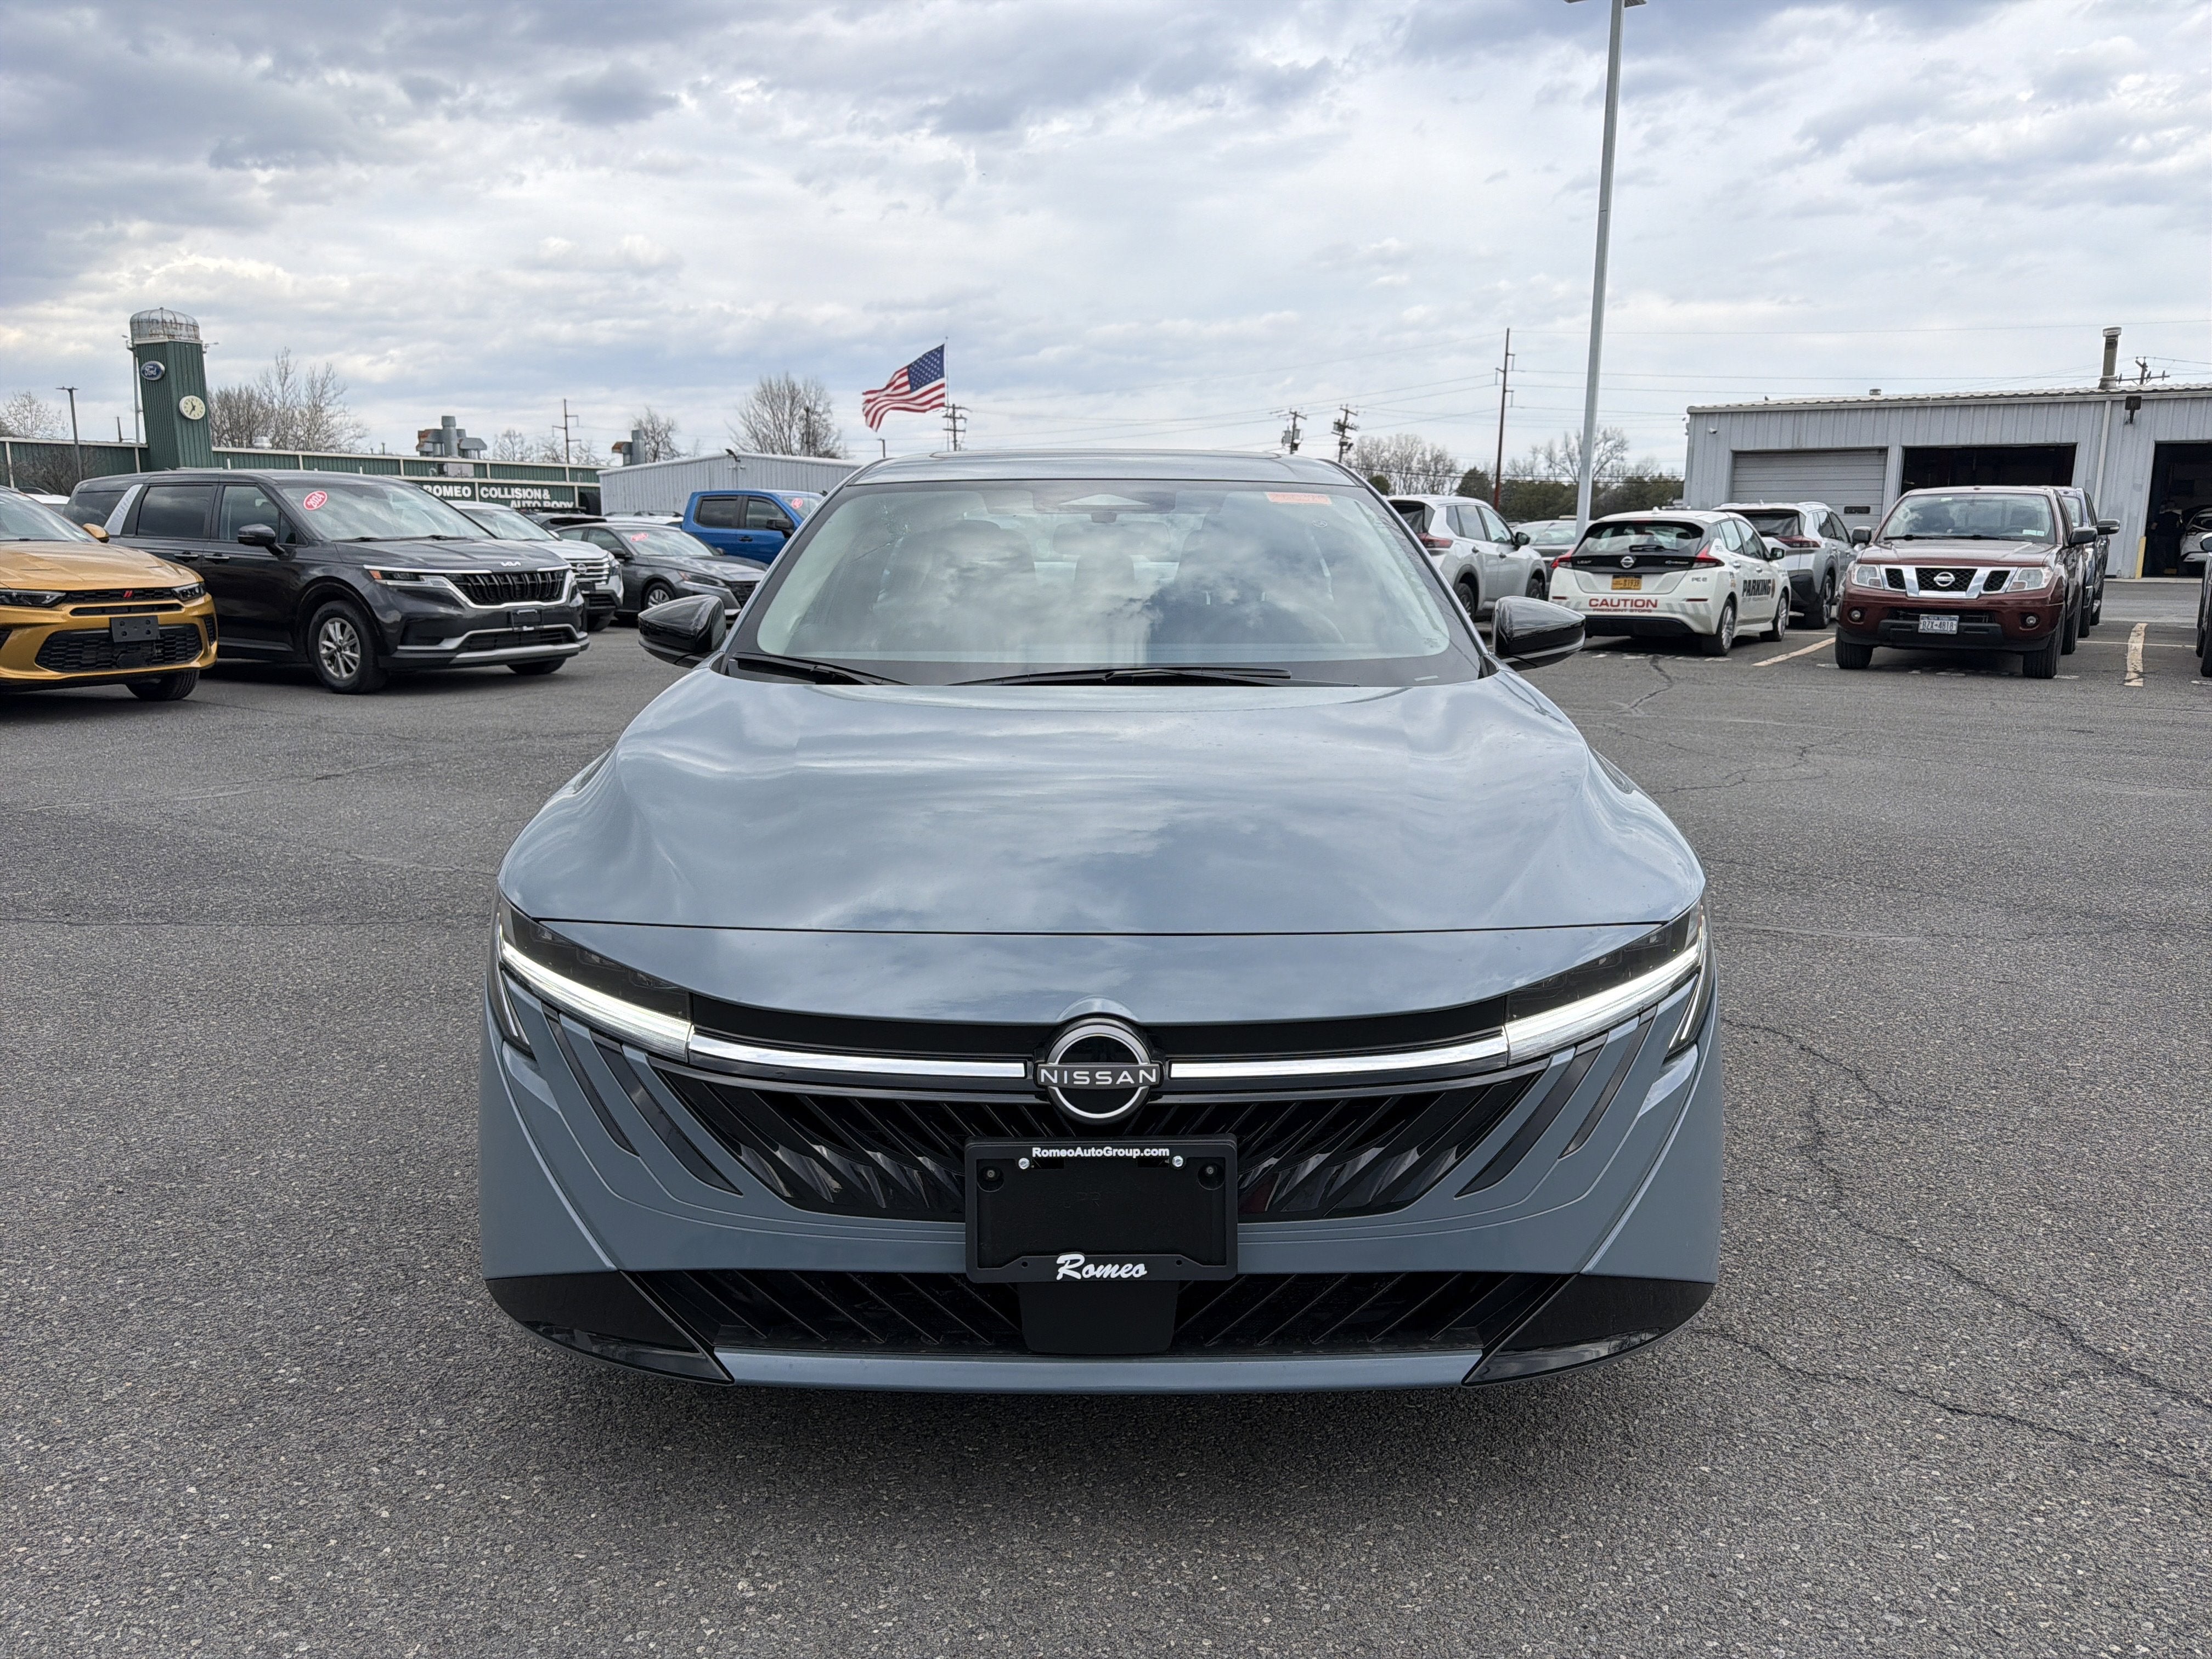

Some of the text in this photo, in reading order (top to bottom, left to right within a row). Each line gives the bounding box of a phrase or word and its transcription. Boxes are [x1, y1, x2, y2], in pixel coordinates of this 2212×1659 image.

[480, 487, 541, 500] COLLISION
[543, 488, 551, 500] &
[510, 500, 541, 509] AUTO
[1742, 579, 1771, 597] PARKING
[1589, 598, 1658, 608] CAUTION
[1041, 1069, 1156, 1085] NISSAN
[1032, 1147, 1170, 1158] RomeoAutoGroup.com
[1056, 1254, 1148, 1280] Romeo
